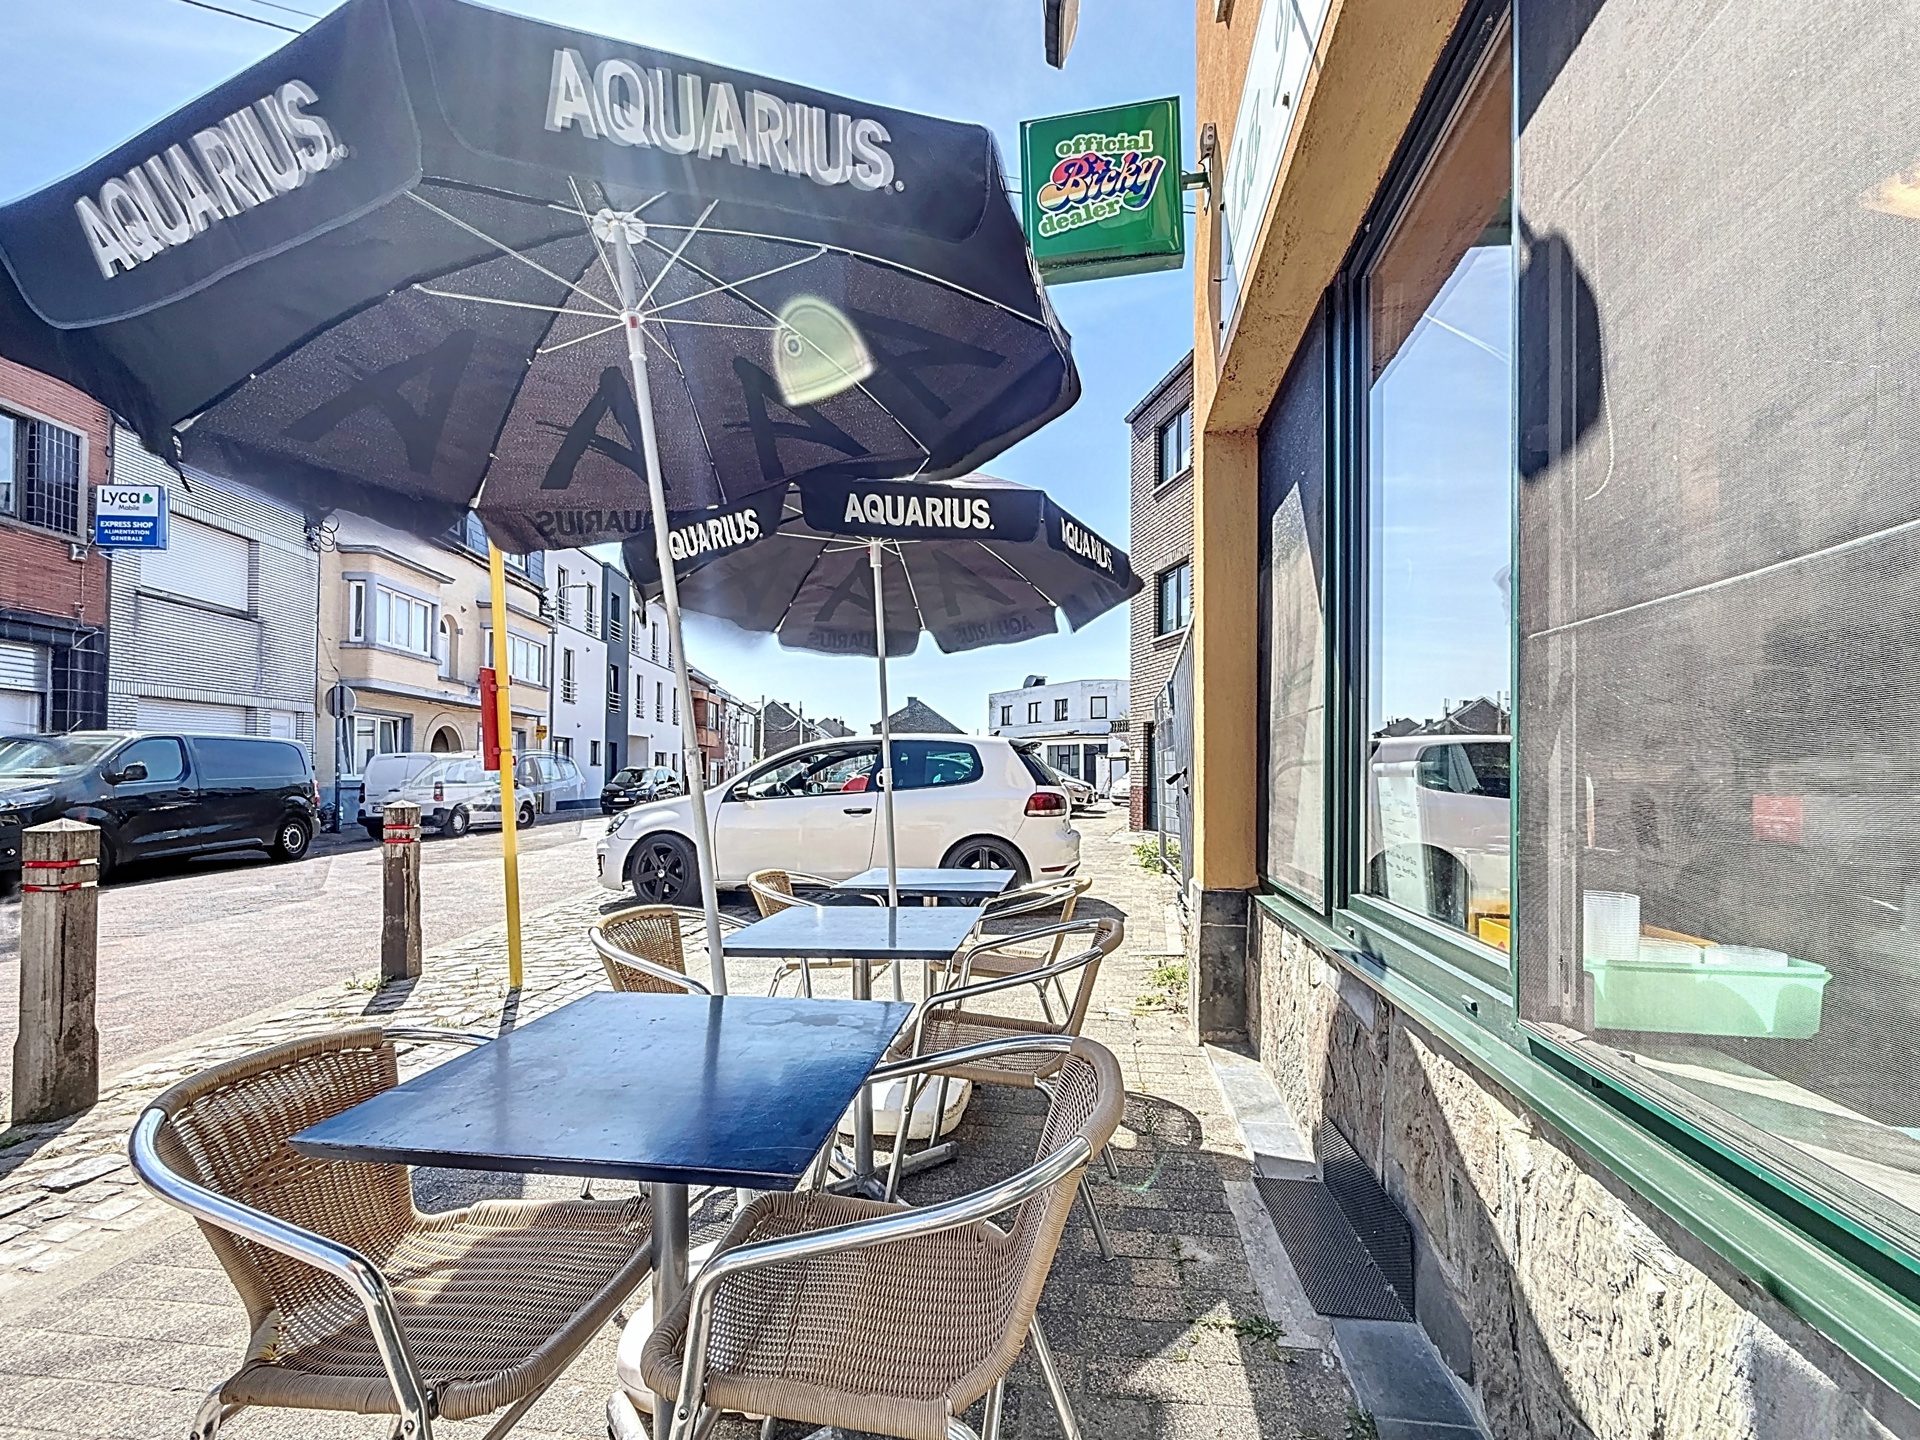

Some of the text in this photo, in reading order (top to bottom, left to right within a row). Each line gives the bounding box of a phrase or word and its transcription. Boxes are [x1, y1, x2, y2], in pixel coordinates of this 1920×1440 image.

[1056, 132, 1153, 156] official
[1038, 151, 1166, 210] Bicky
[1040, 198, 1122, 236] dealer
[101, 488, 141, 506] Lyca
[100, 520, 154, 529] EXPRESS SHOP
[103, 528, 150, 536] ALIMENTATION
[667, 508, 762, 561] QUARIUS
